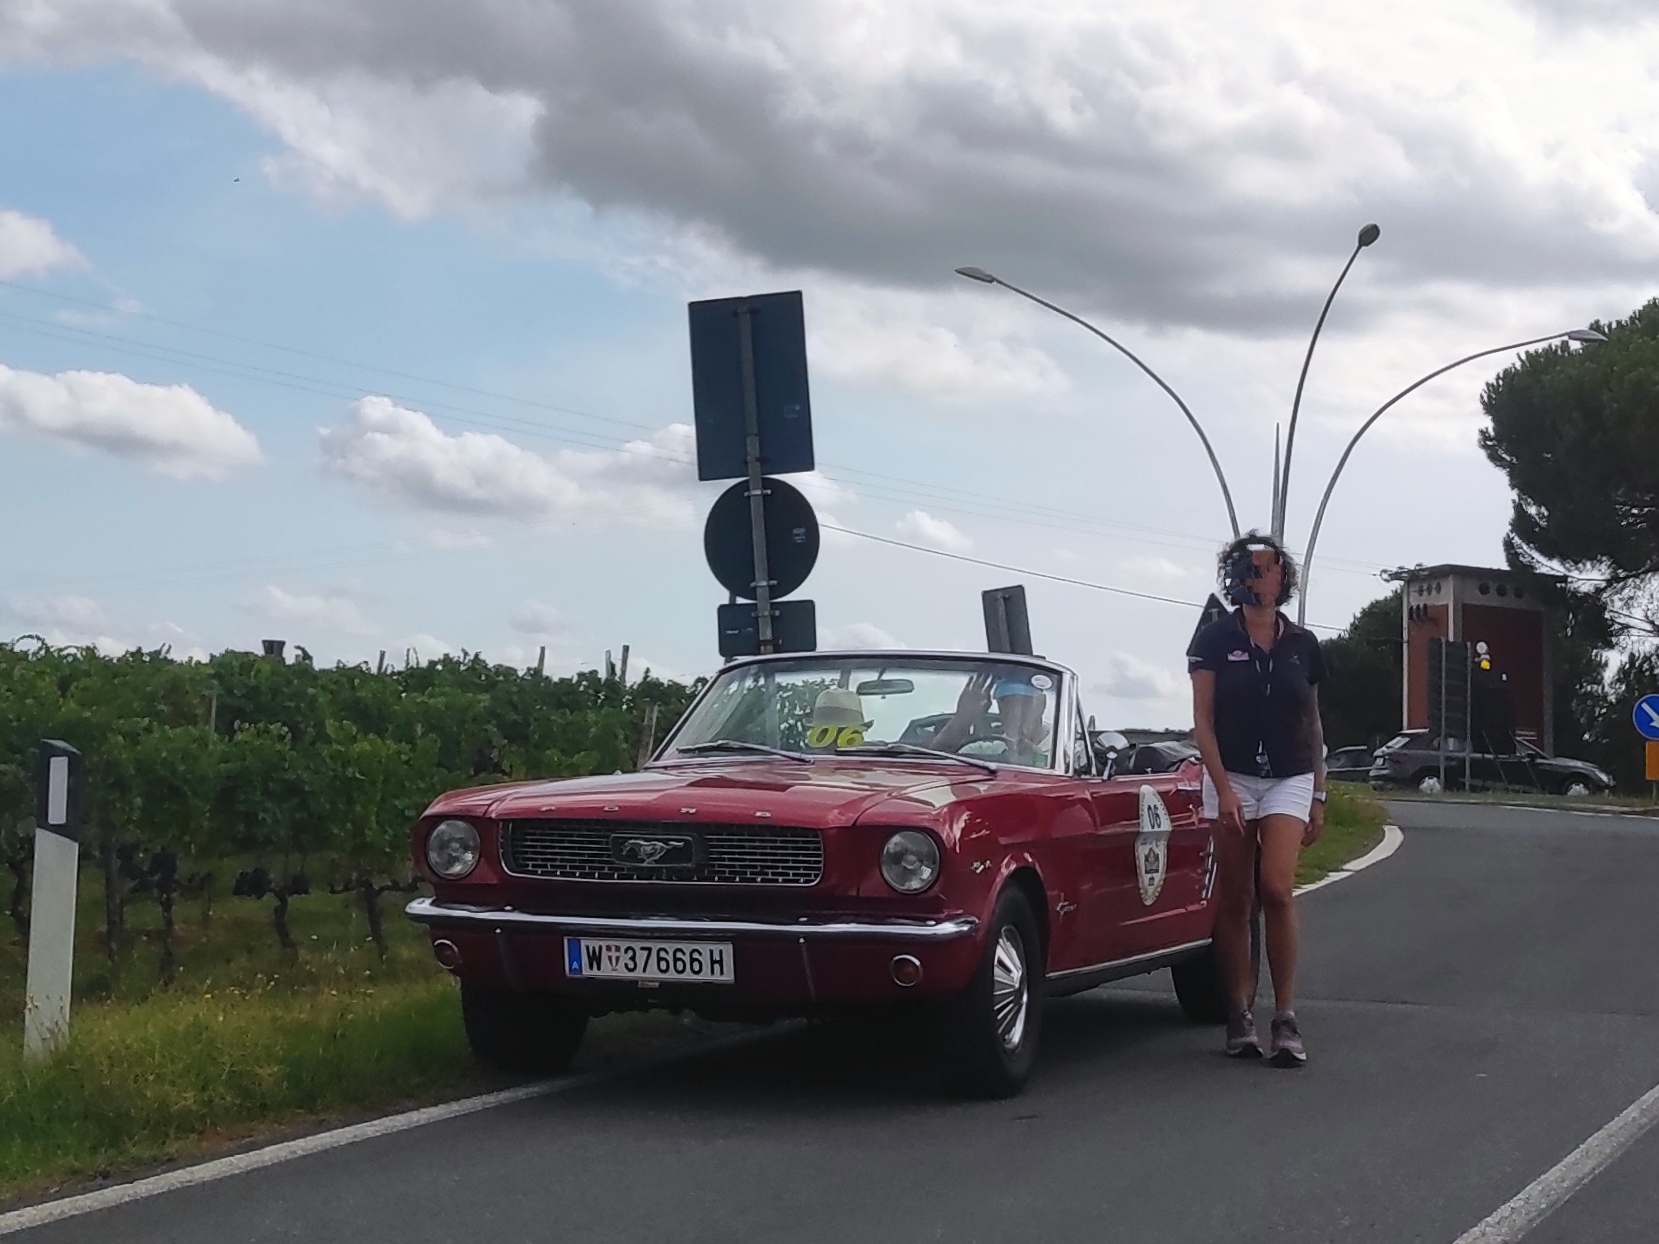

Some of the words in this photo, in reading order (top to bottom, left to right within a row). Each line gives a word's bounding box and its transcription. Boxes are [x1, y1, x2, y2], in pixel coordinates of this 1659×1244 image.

[807, 724, 867, 748] 06
[1147, 804, 1162, 829] 06
[585, 944, 603, 971] W
